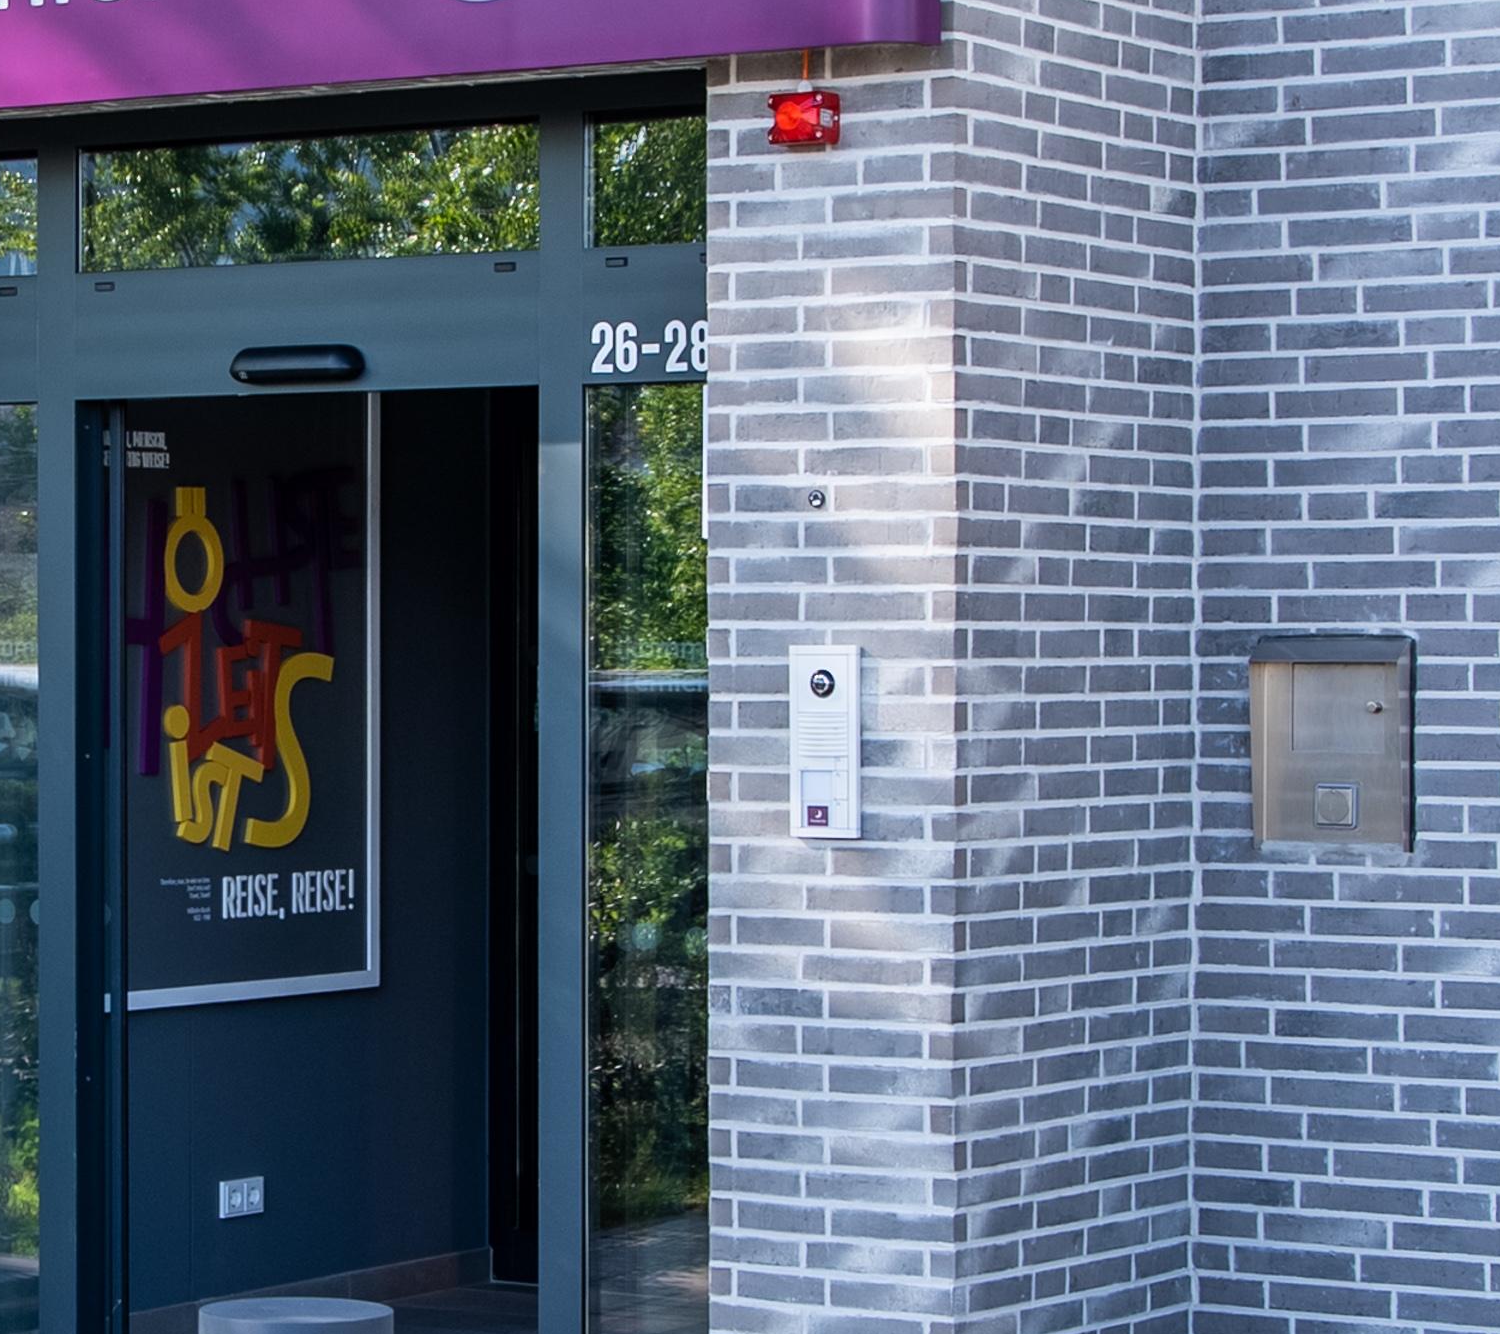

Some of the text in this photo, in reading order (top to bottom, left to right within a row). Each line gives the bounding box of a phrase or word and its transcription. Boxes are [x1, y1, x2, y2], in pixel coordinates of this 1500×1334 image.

[591, 319, 708, 373] 26-28
[222, 869, 354, 919] REISE, REISE!
